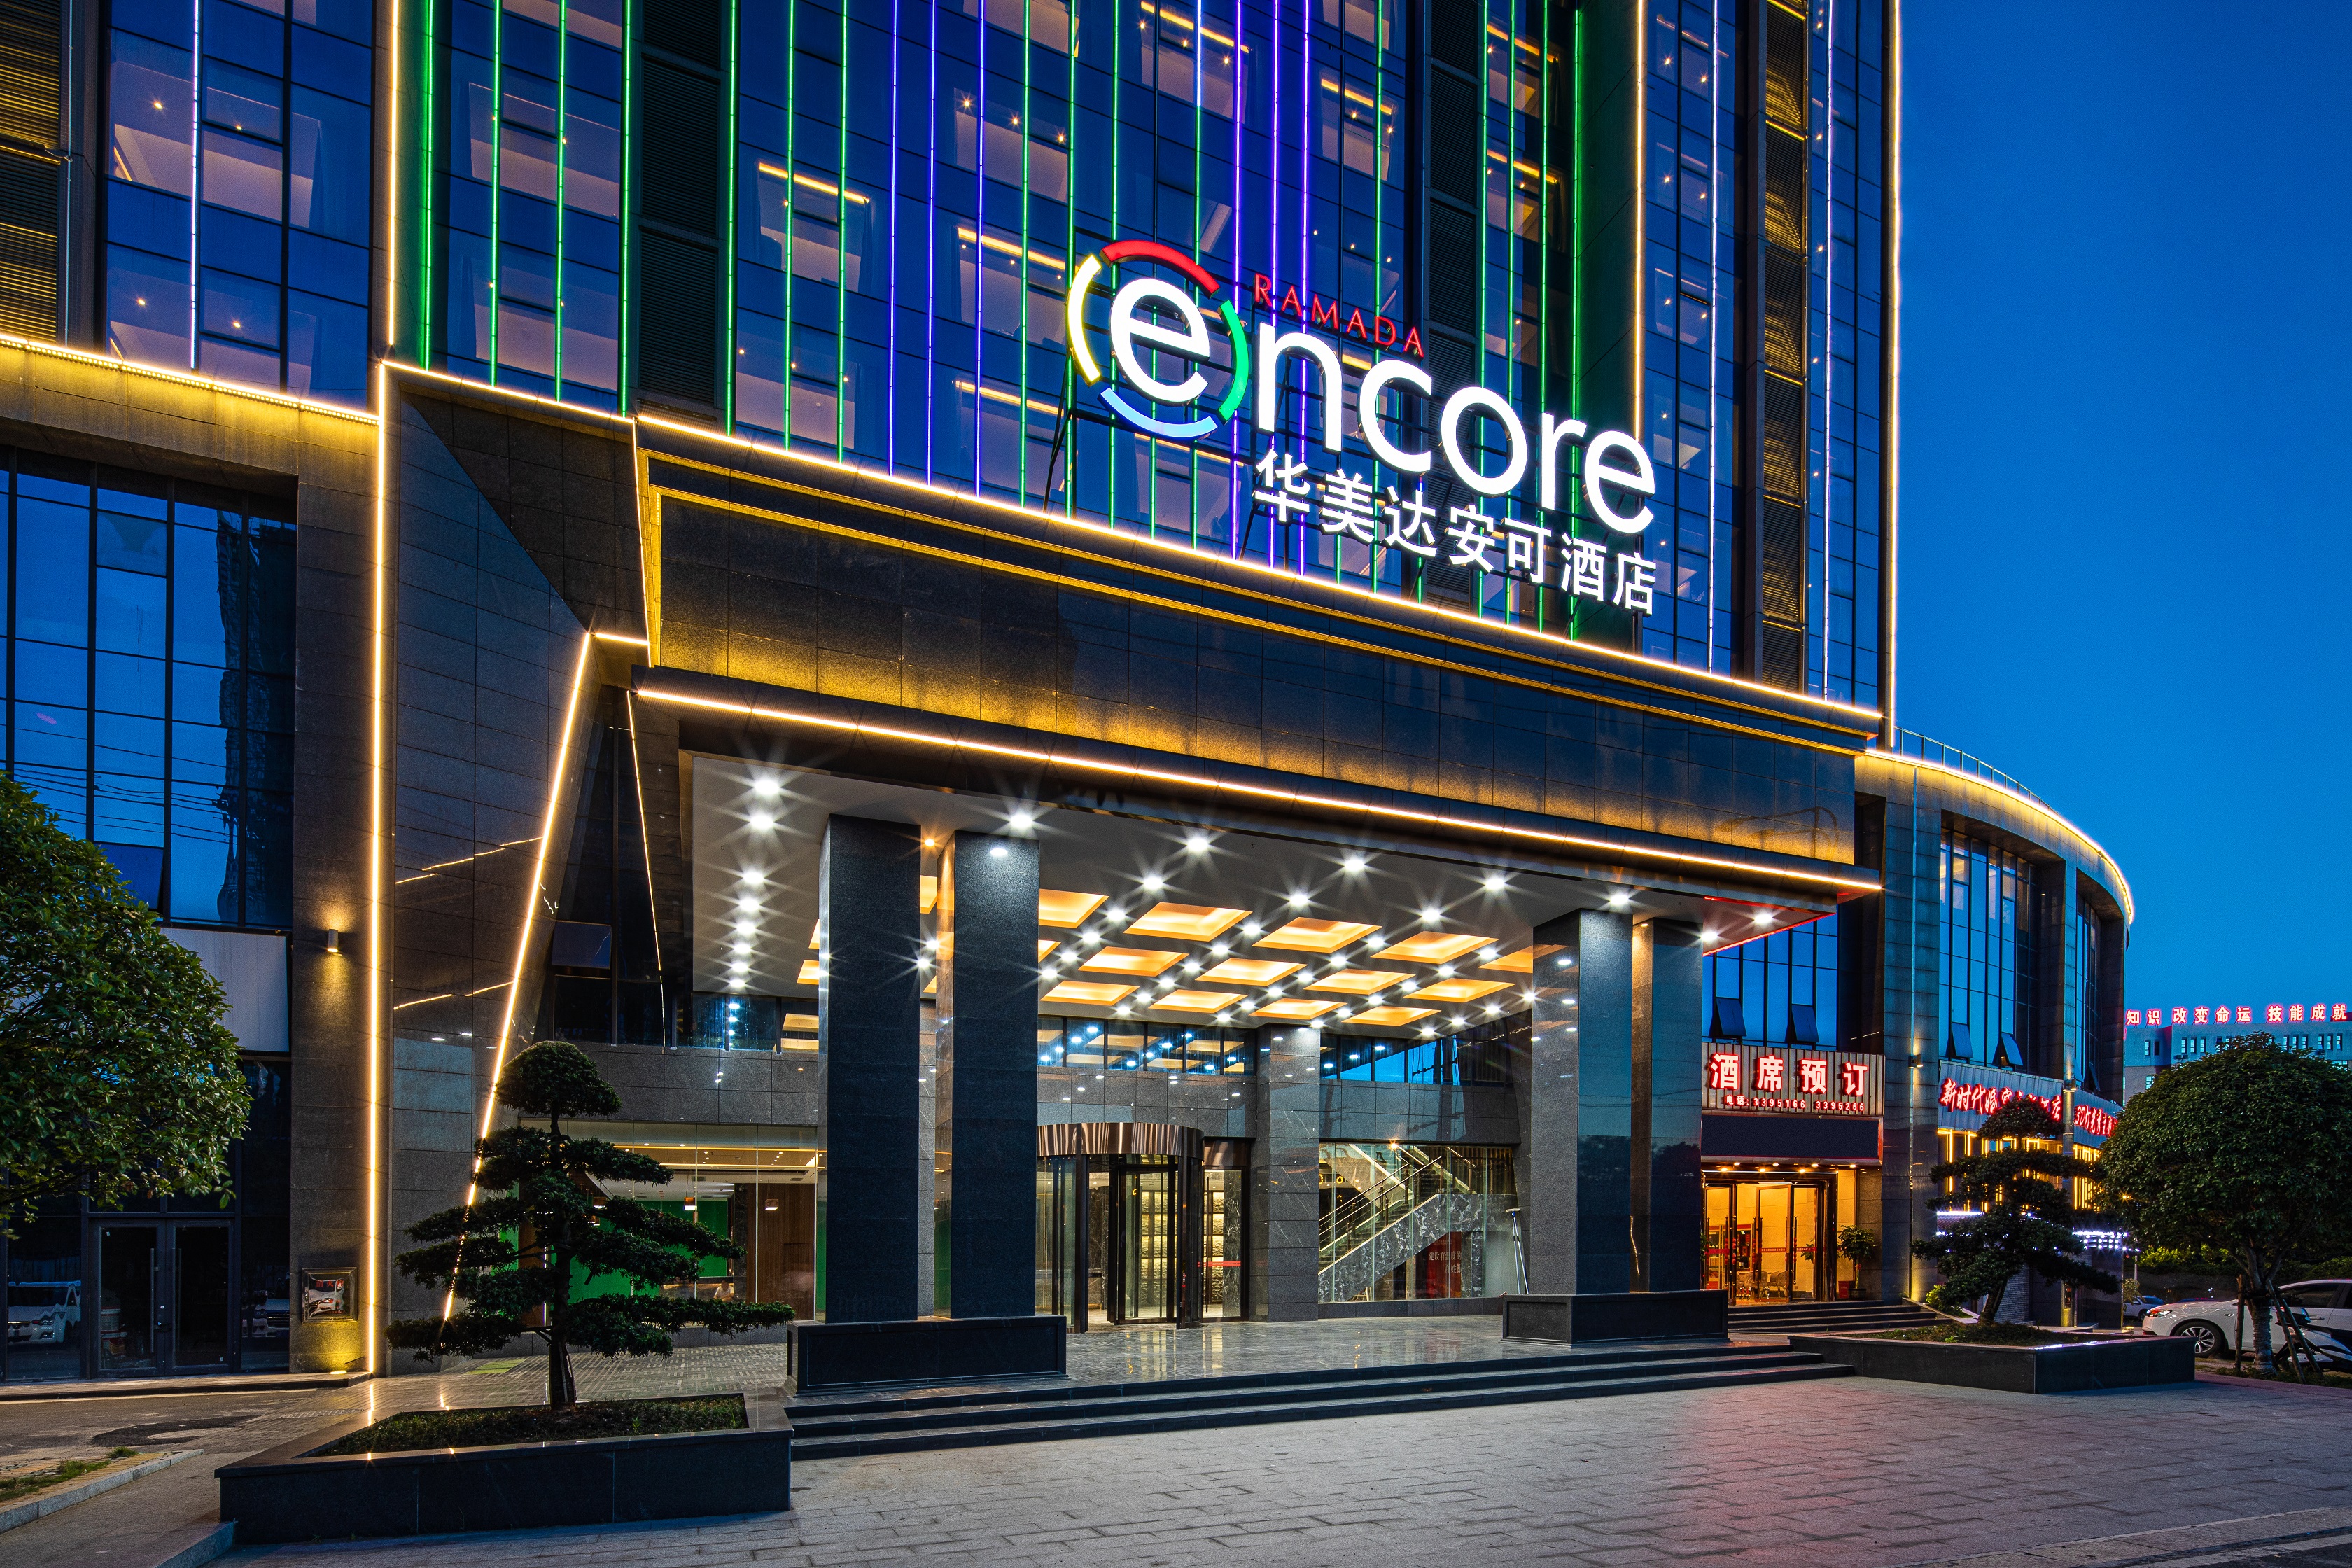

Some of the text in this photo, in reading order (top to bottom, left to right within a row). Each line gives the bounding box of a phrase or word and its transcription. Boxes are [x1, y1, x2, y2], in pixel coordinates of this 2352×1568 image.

[1254, 272, 1424, 358] RAMADA
[1110, 278, 1655, 536] encore
[1252, 449, 1657, 617] 华美达安可酒店
[2126, 1003, 2347, 1026] 知识改变命运 技能成就
[1709, 1052, 1868, 1097] 酒席预订
[1814, 1100, 1865, 1112] 3395266
